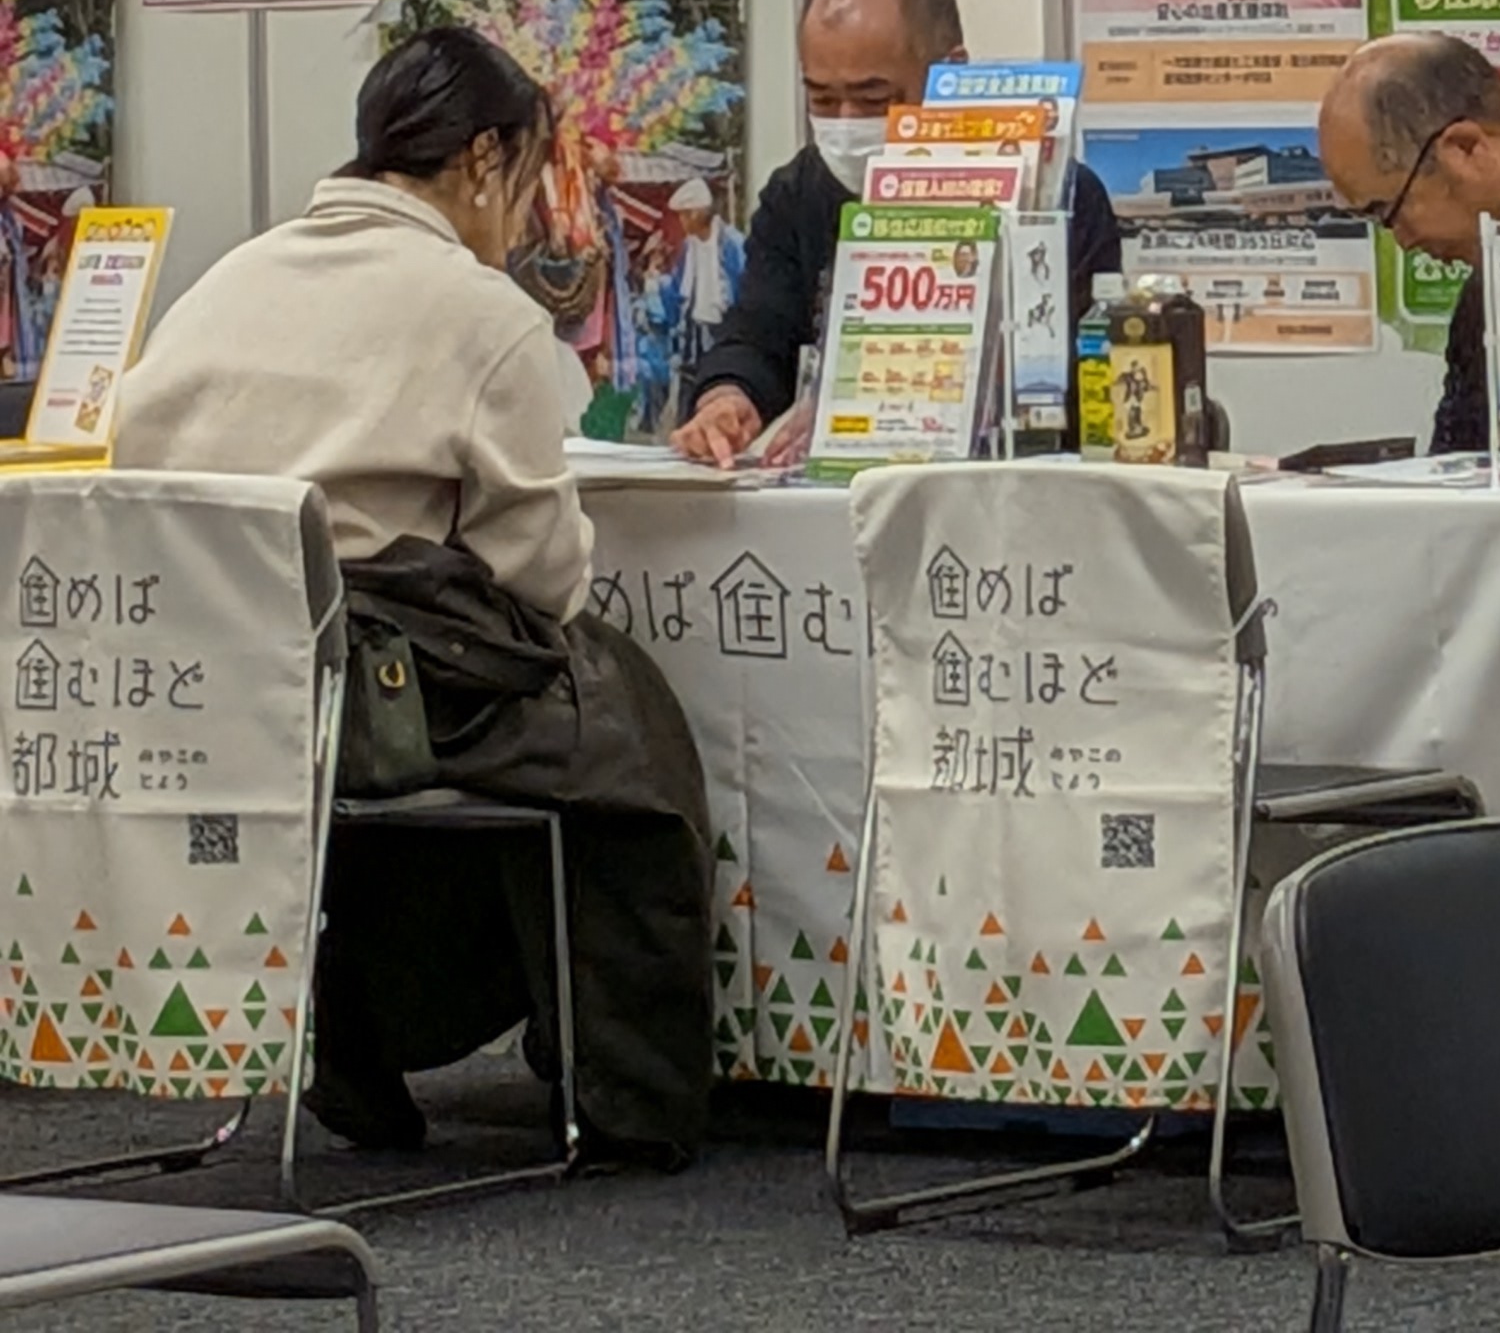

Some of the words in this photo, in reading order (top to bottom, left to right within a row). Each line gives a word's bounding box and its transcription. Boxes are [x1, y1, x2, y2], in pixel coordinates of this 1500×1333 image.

[19, 555, 160, 627] 住めば
[926, 544, 1073, 619] 住めば
[15, 638, 204, 710] 住むほど
[932, 630, 1119, 706] 住むほど
[12, 730, 121, 801] 都城
[930, 726, 1034, 798] 都城
